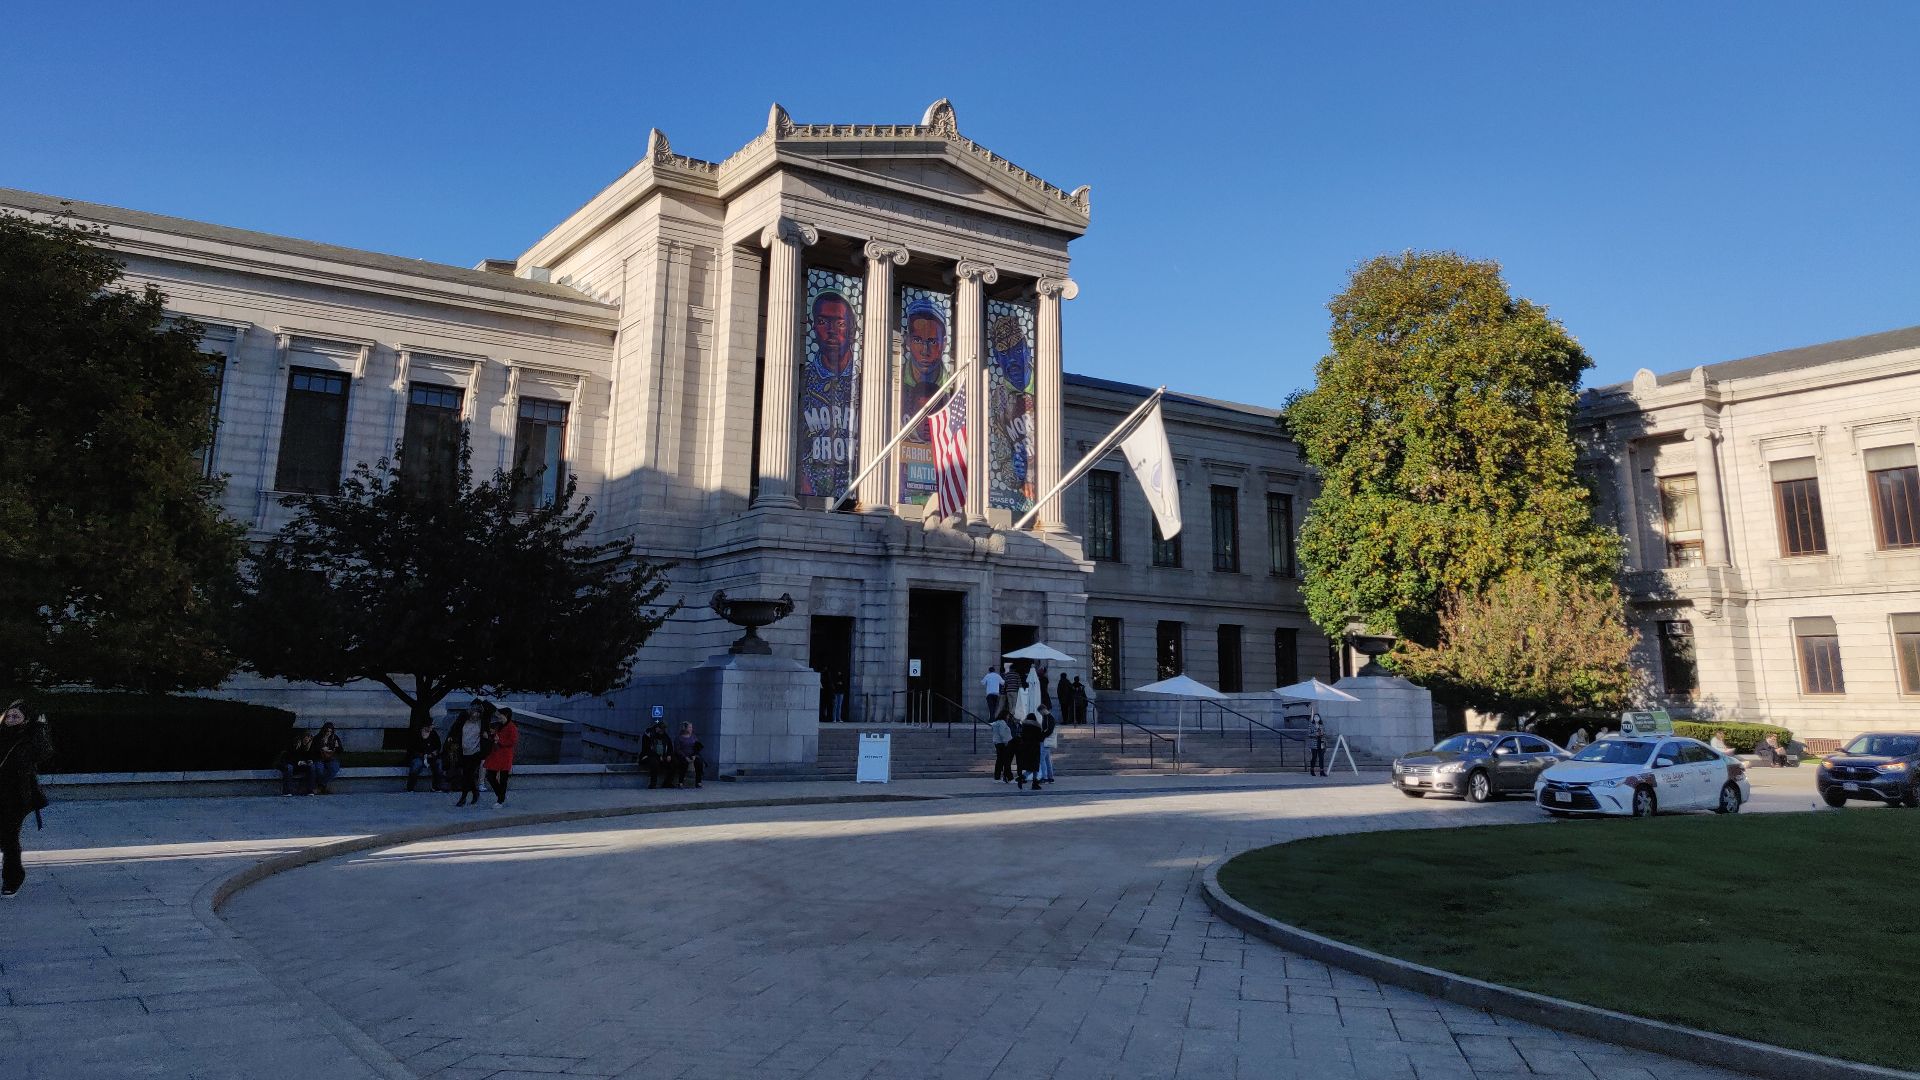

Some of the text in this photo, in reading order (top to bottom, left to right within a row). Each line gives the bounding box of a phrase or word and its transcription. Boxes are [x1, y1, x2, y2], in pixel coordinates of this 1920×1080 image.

[944, 215, 983, 236] FINE
[992, 227, 1033, 246] ARTS
[901, 446, 931, 461] FABRIC
[910, 464, 936, 480] NATIO
